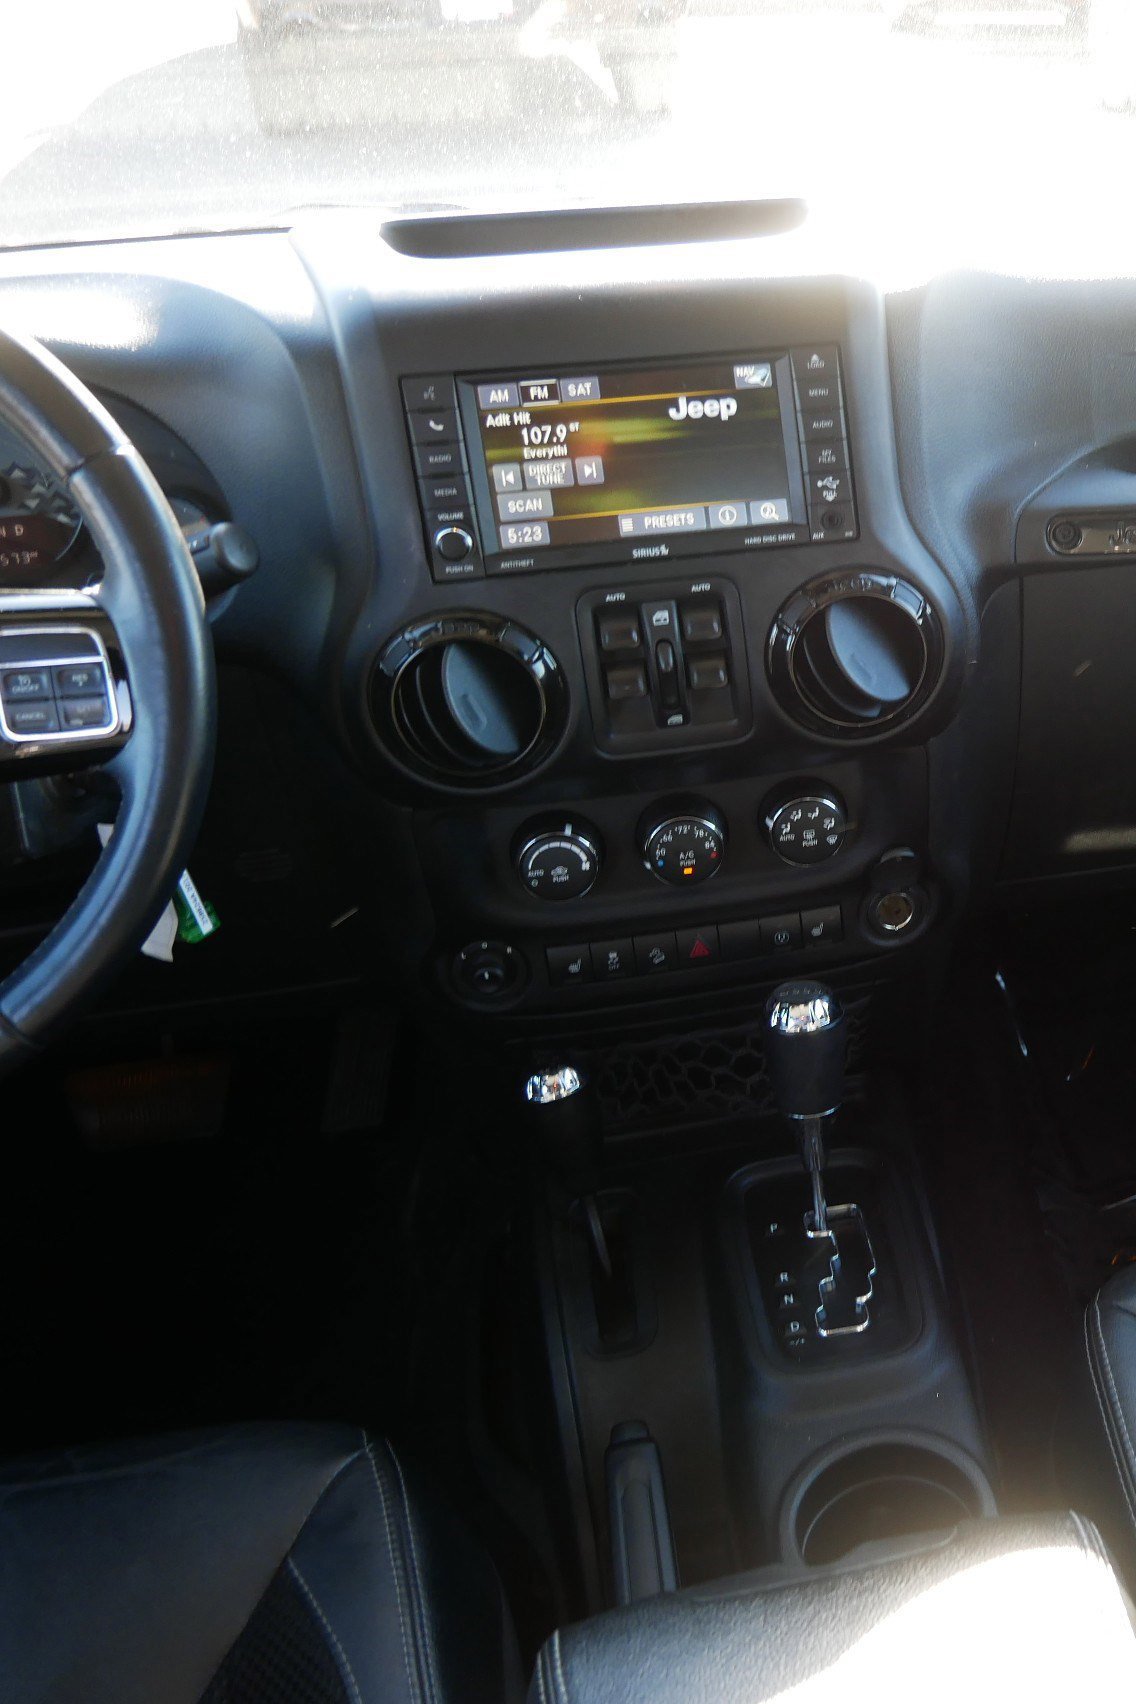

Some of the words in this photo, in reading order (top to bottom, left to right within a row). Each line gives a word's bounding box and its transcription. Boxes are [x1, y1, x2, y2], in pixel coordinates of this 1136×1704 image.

[736, 365, 755, 378] NAV
[490, 389, 509, 403] AM
[529, 385, 549, 400] FM
[567, 382, 592, 397] SAT
[668, 396, 738, 421] Jeep
[513, 411, 531, 426] Hit
[521, 423, 567, 446] 107.9
[507, 498, 543, 513] SCAN
[644, 512, 695, 530] PRESETS
[507, 525, 543, 544] 5:23
[632, 546, 661, 559] SIRIUS
[692, 582, 711, 593] AUTO
[605, 592, 626, 602] AUTO
